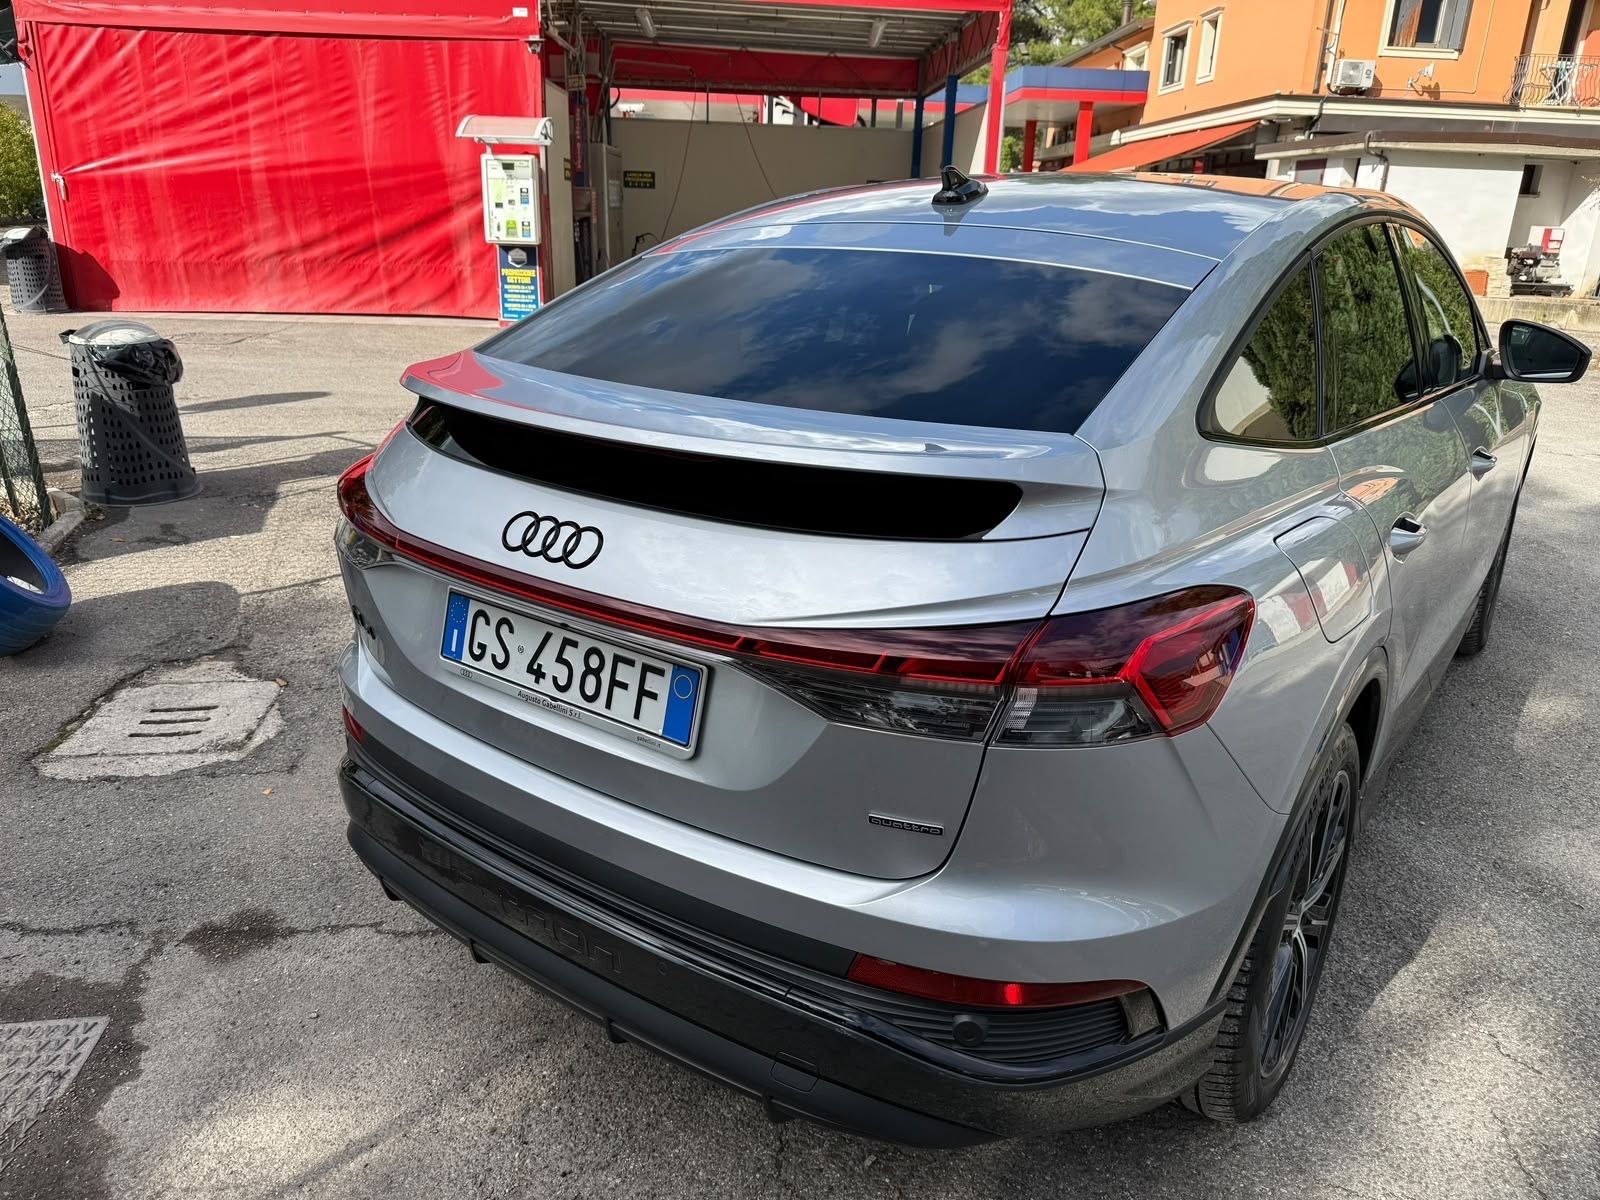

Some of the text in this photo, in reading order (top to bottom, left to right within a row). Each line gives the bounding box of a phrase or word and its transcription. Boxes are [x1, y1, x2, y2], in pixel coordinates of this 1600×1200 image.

[468, 609, 666, 721] GS 458FF
[517, 690, 541, 705] Augusto
[542, 699, 568, 715] Gabellini
[870, 817, 941, 834] quattro
